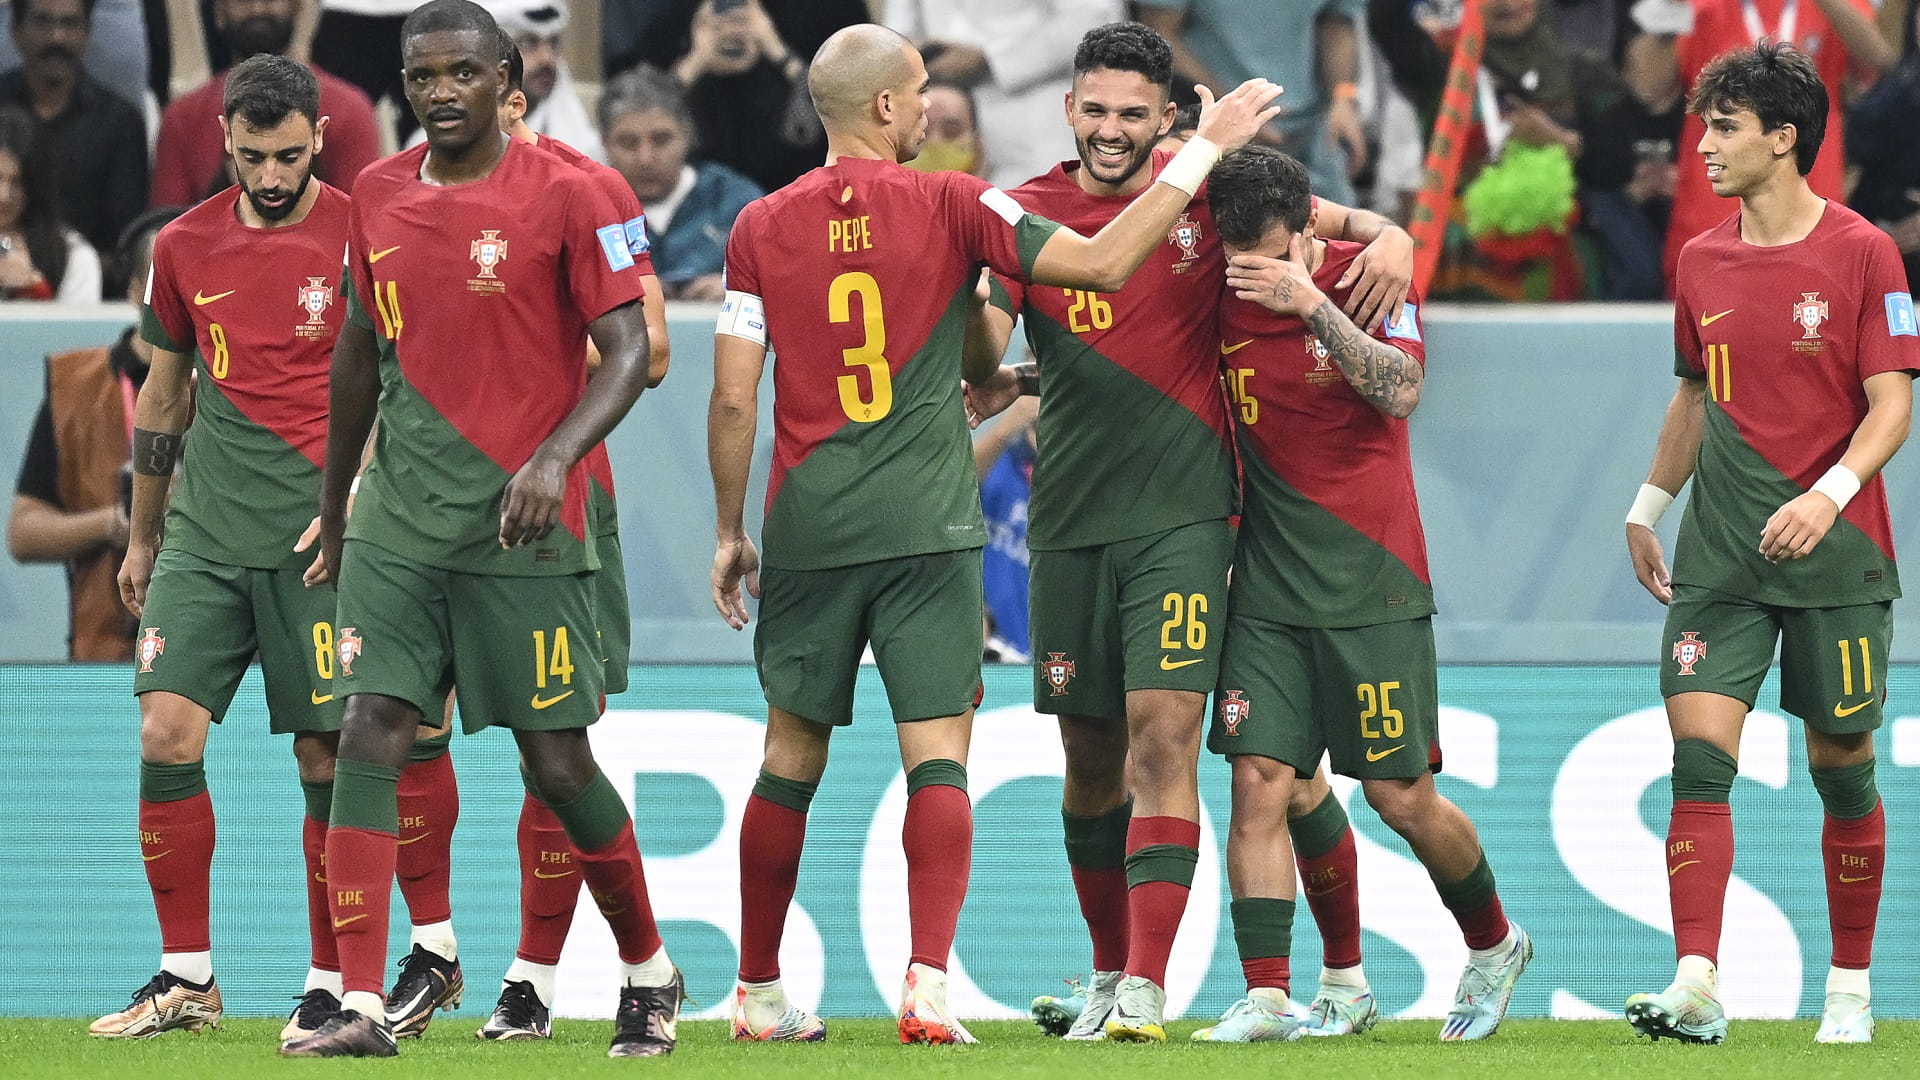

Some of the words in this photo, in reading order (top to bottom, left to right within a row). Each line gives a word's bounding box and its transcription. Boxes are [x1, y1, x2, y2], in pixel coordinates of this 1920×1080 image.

[828, 215, 873, 252] PEPE
[374, 280, 403, 340] 14
[1063, 288, 1113, 334] 26
[209, 322, 229, 379] 8
[828, 271, 893, 423] 3
[1707, 343, 1731, 402] 11
[312, 621, 334, 680] 8
[1160, 592, 1208, 651] 26
[532, 626, 575, 688] 14
[1838, 636, 1872, 696] 11
[1357, 681, 1404, 739] 25
